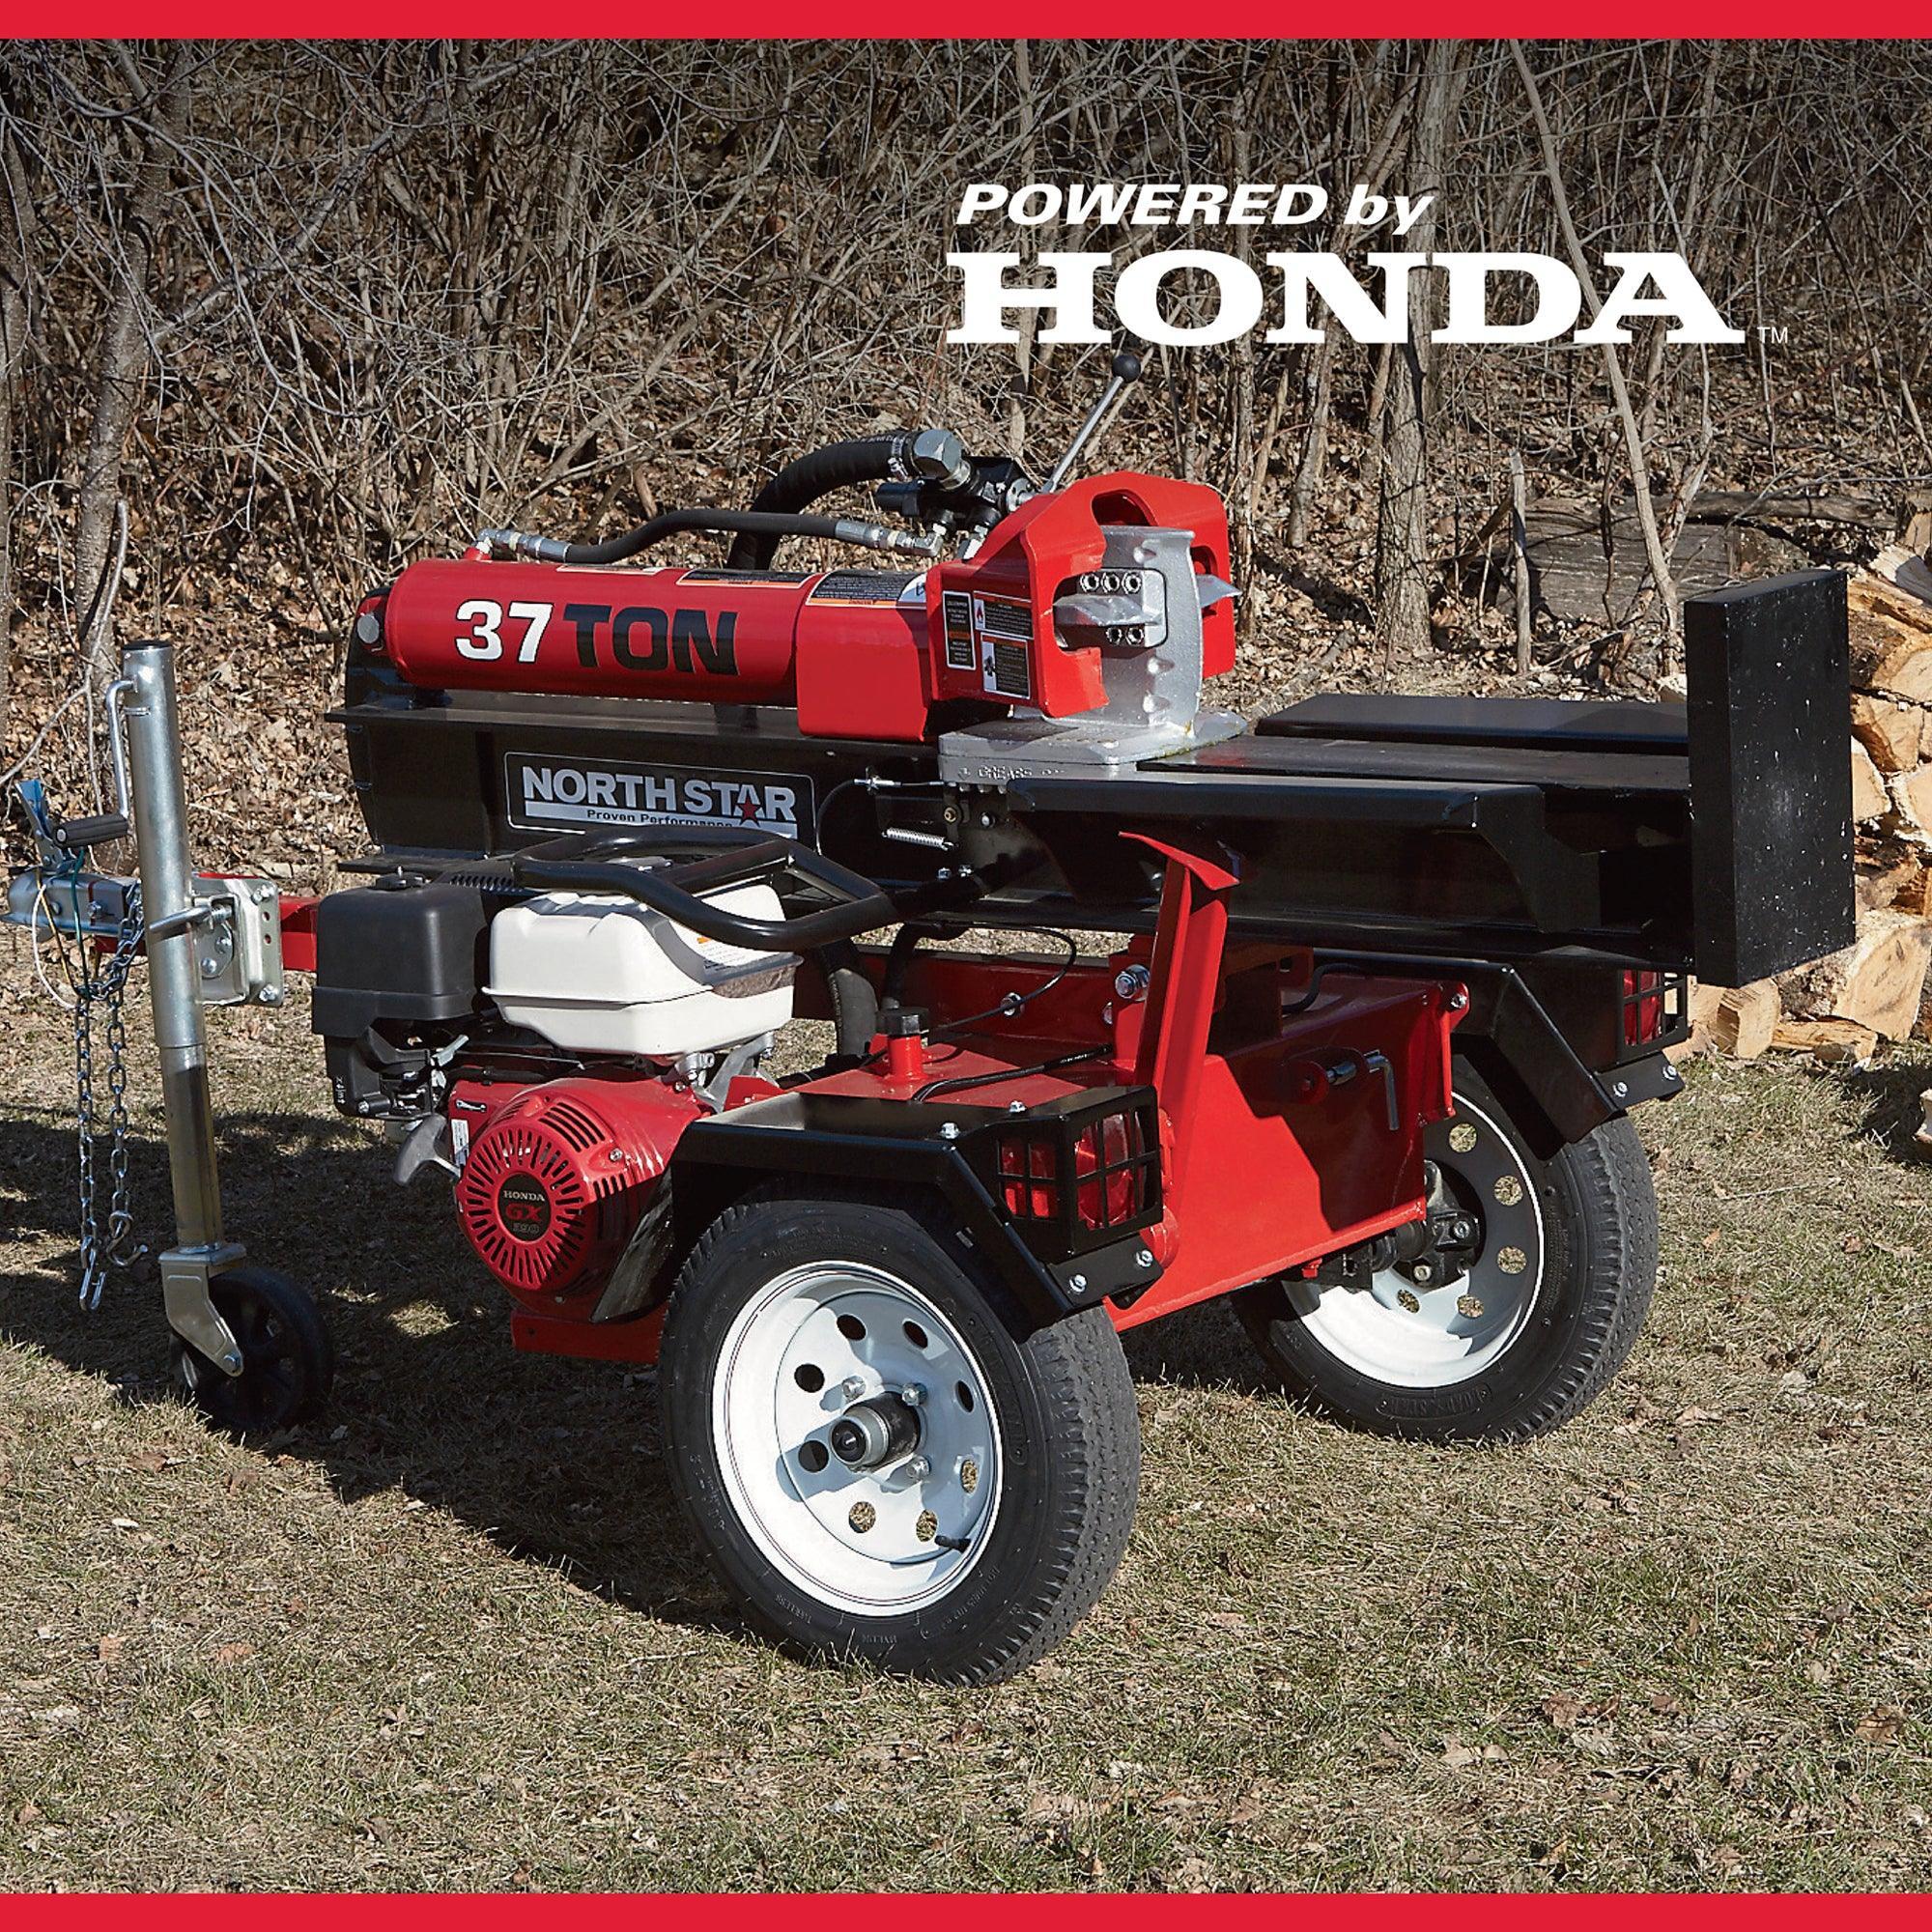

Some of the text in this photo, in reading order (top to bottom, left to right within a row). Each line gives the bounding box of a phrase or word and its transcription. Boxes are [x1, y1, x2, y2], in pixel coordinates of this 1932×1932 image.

[456, 599, 740, 676] 37 TON
[587, 809, 636, 822] Proven
[503, 1189, 546, 1202] HONDA
[505, 1202, 542, 1221] GX
